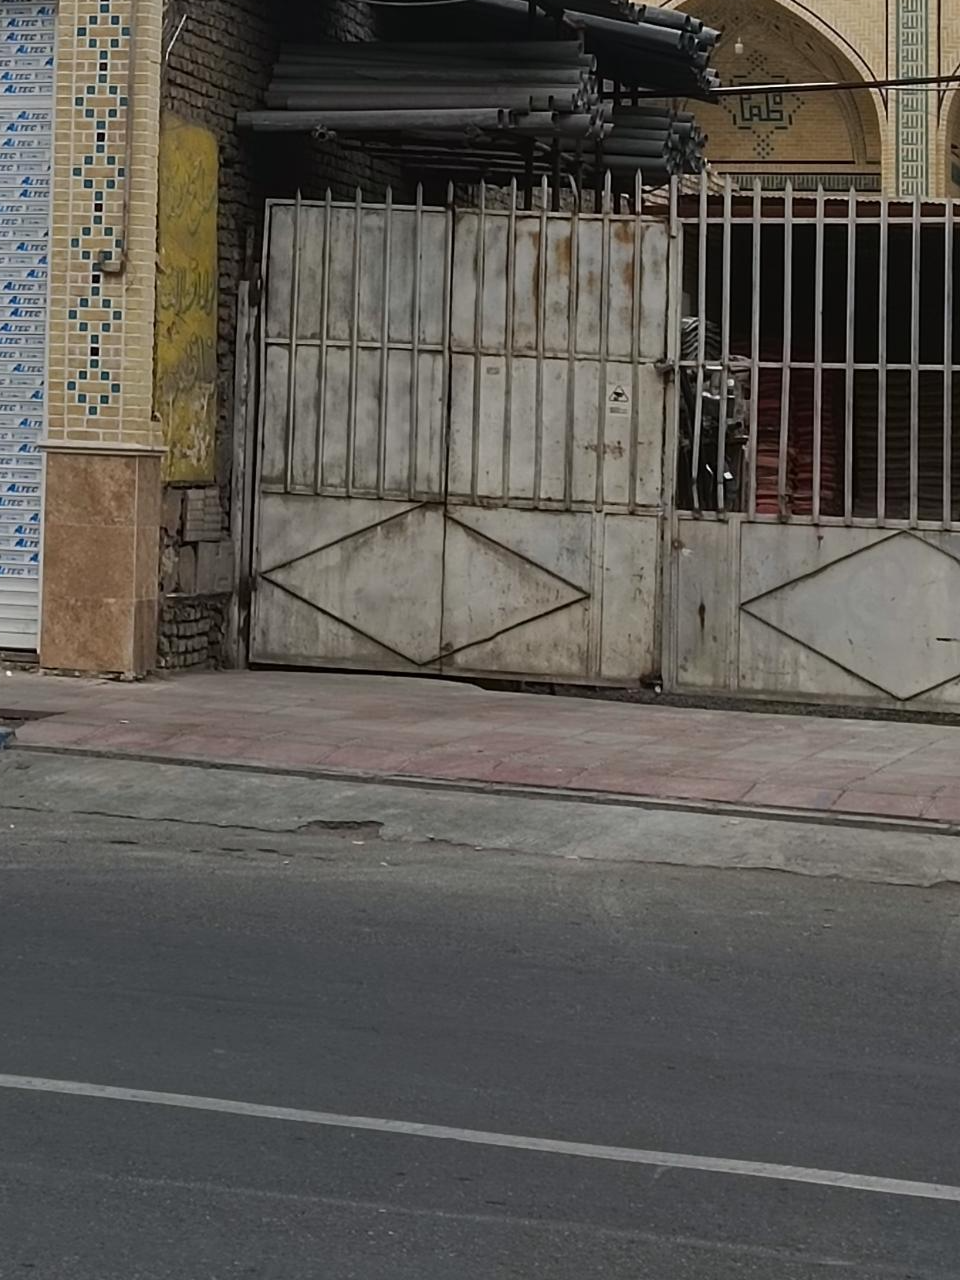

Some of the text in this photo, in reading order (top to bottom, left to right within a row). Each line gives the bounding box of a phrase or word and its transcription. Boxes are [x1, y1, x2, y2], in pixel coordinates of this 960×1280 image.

[7, 18, 38, 27] ALTEC
[16, 45, 47, 54] ALTEC
[1, 72, 32, 81] ALTEC
[5, 85, 36, 94] ALTEC
[7, 123, 38, 132] ALTEC
[20, 189, 51, 198] ALTEC
[16, 243, 47, 252] ALTEC
[4, 282, 35, 291] ALTEC
[9, 296, 40, 305] ALTEC
[10, 309, 41, 318] ALTEC
[13, 364, 44, 373] ALTEC
[7, 484, 38, 493] ALTEC
